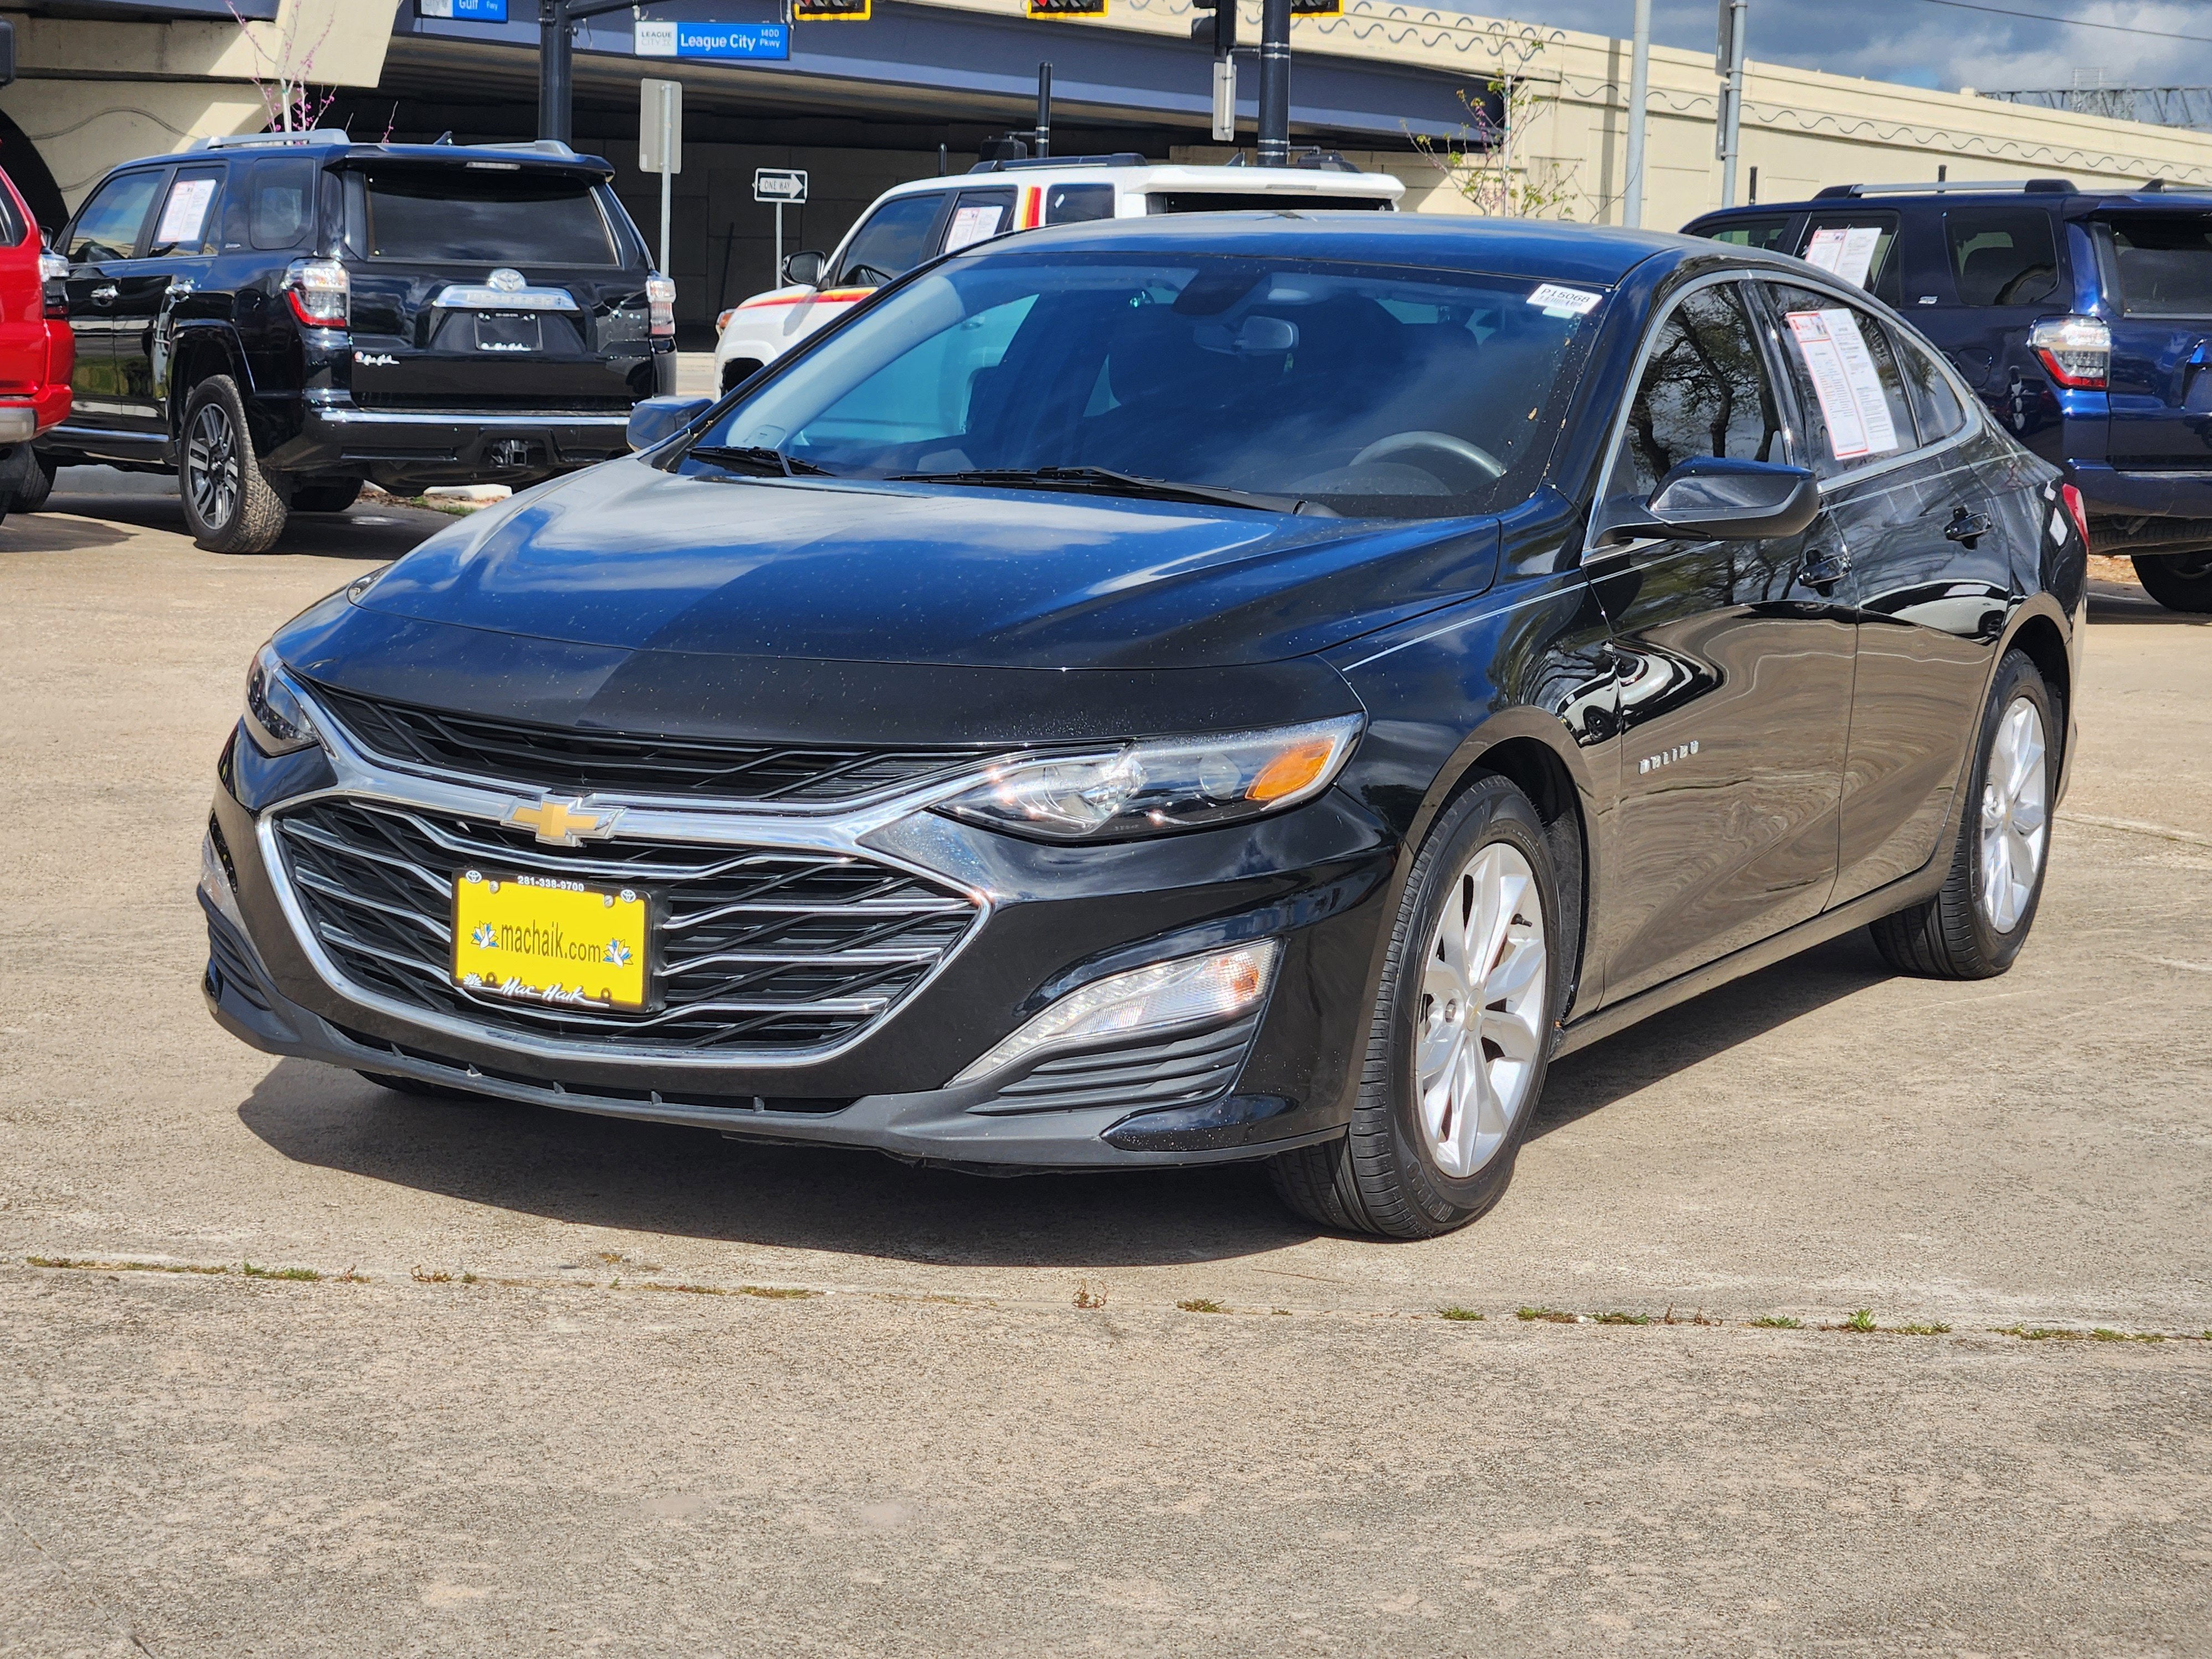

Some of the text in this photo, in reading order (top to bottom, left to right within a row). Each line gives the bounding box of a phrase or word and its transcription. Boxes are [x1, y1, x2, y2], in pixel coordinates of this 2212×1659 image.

[681, 33, 780, 51] League City Pkwy
[761, 29, 779, 38] 1400
[764, 180, 790, 191] ONE WAY
[517, 875, 585, 892] 281-338-9700
[501, 919, 601, 963] machaik.com
[499, 976, 541, 996] Mac
